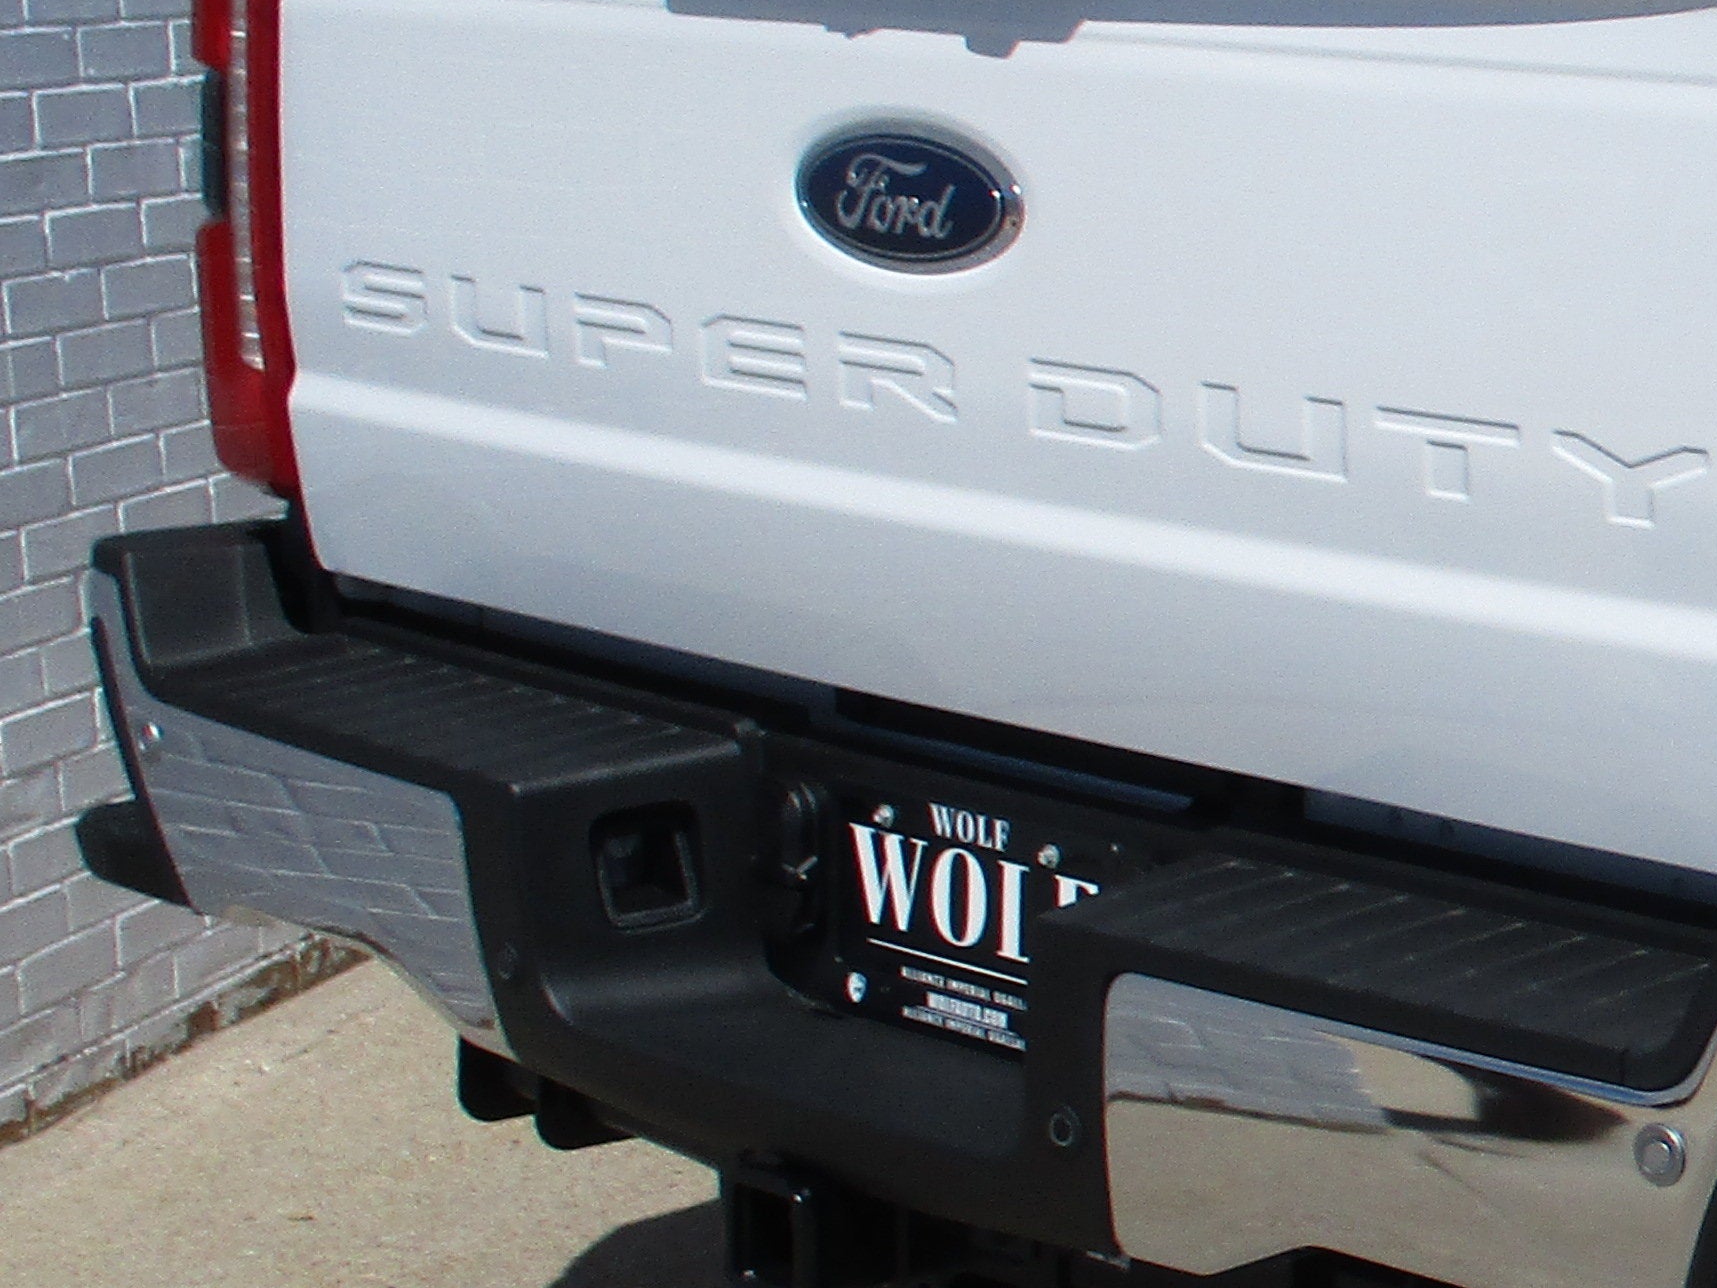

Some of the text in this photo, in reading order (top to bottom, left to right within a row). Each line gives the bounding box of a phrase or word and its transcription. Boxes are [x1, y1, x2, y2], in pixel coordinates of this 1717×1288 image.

[834, 152, 958, 240] Ford
[340, 259, 1712, 530] SUPER DUTY
[928, 801, 1012, 853] WOLF
